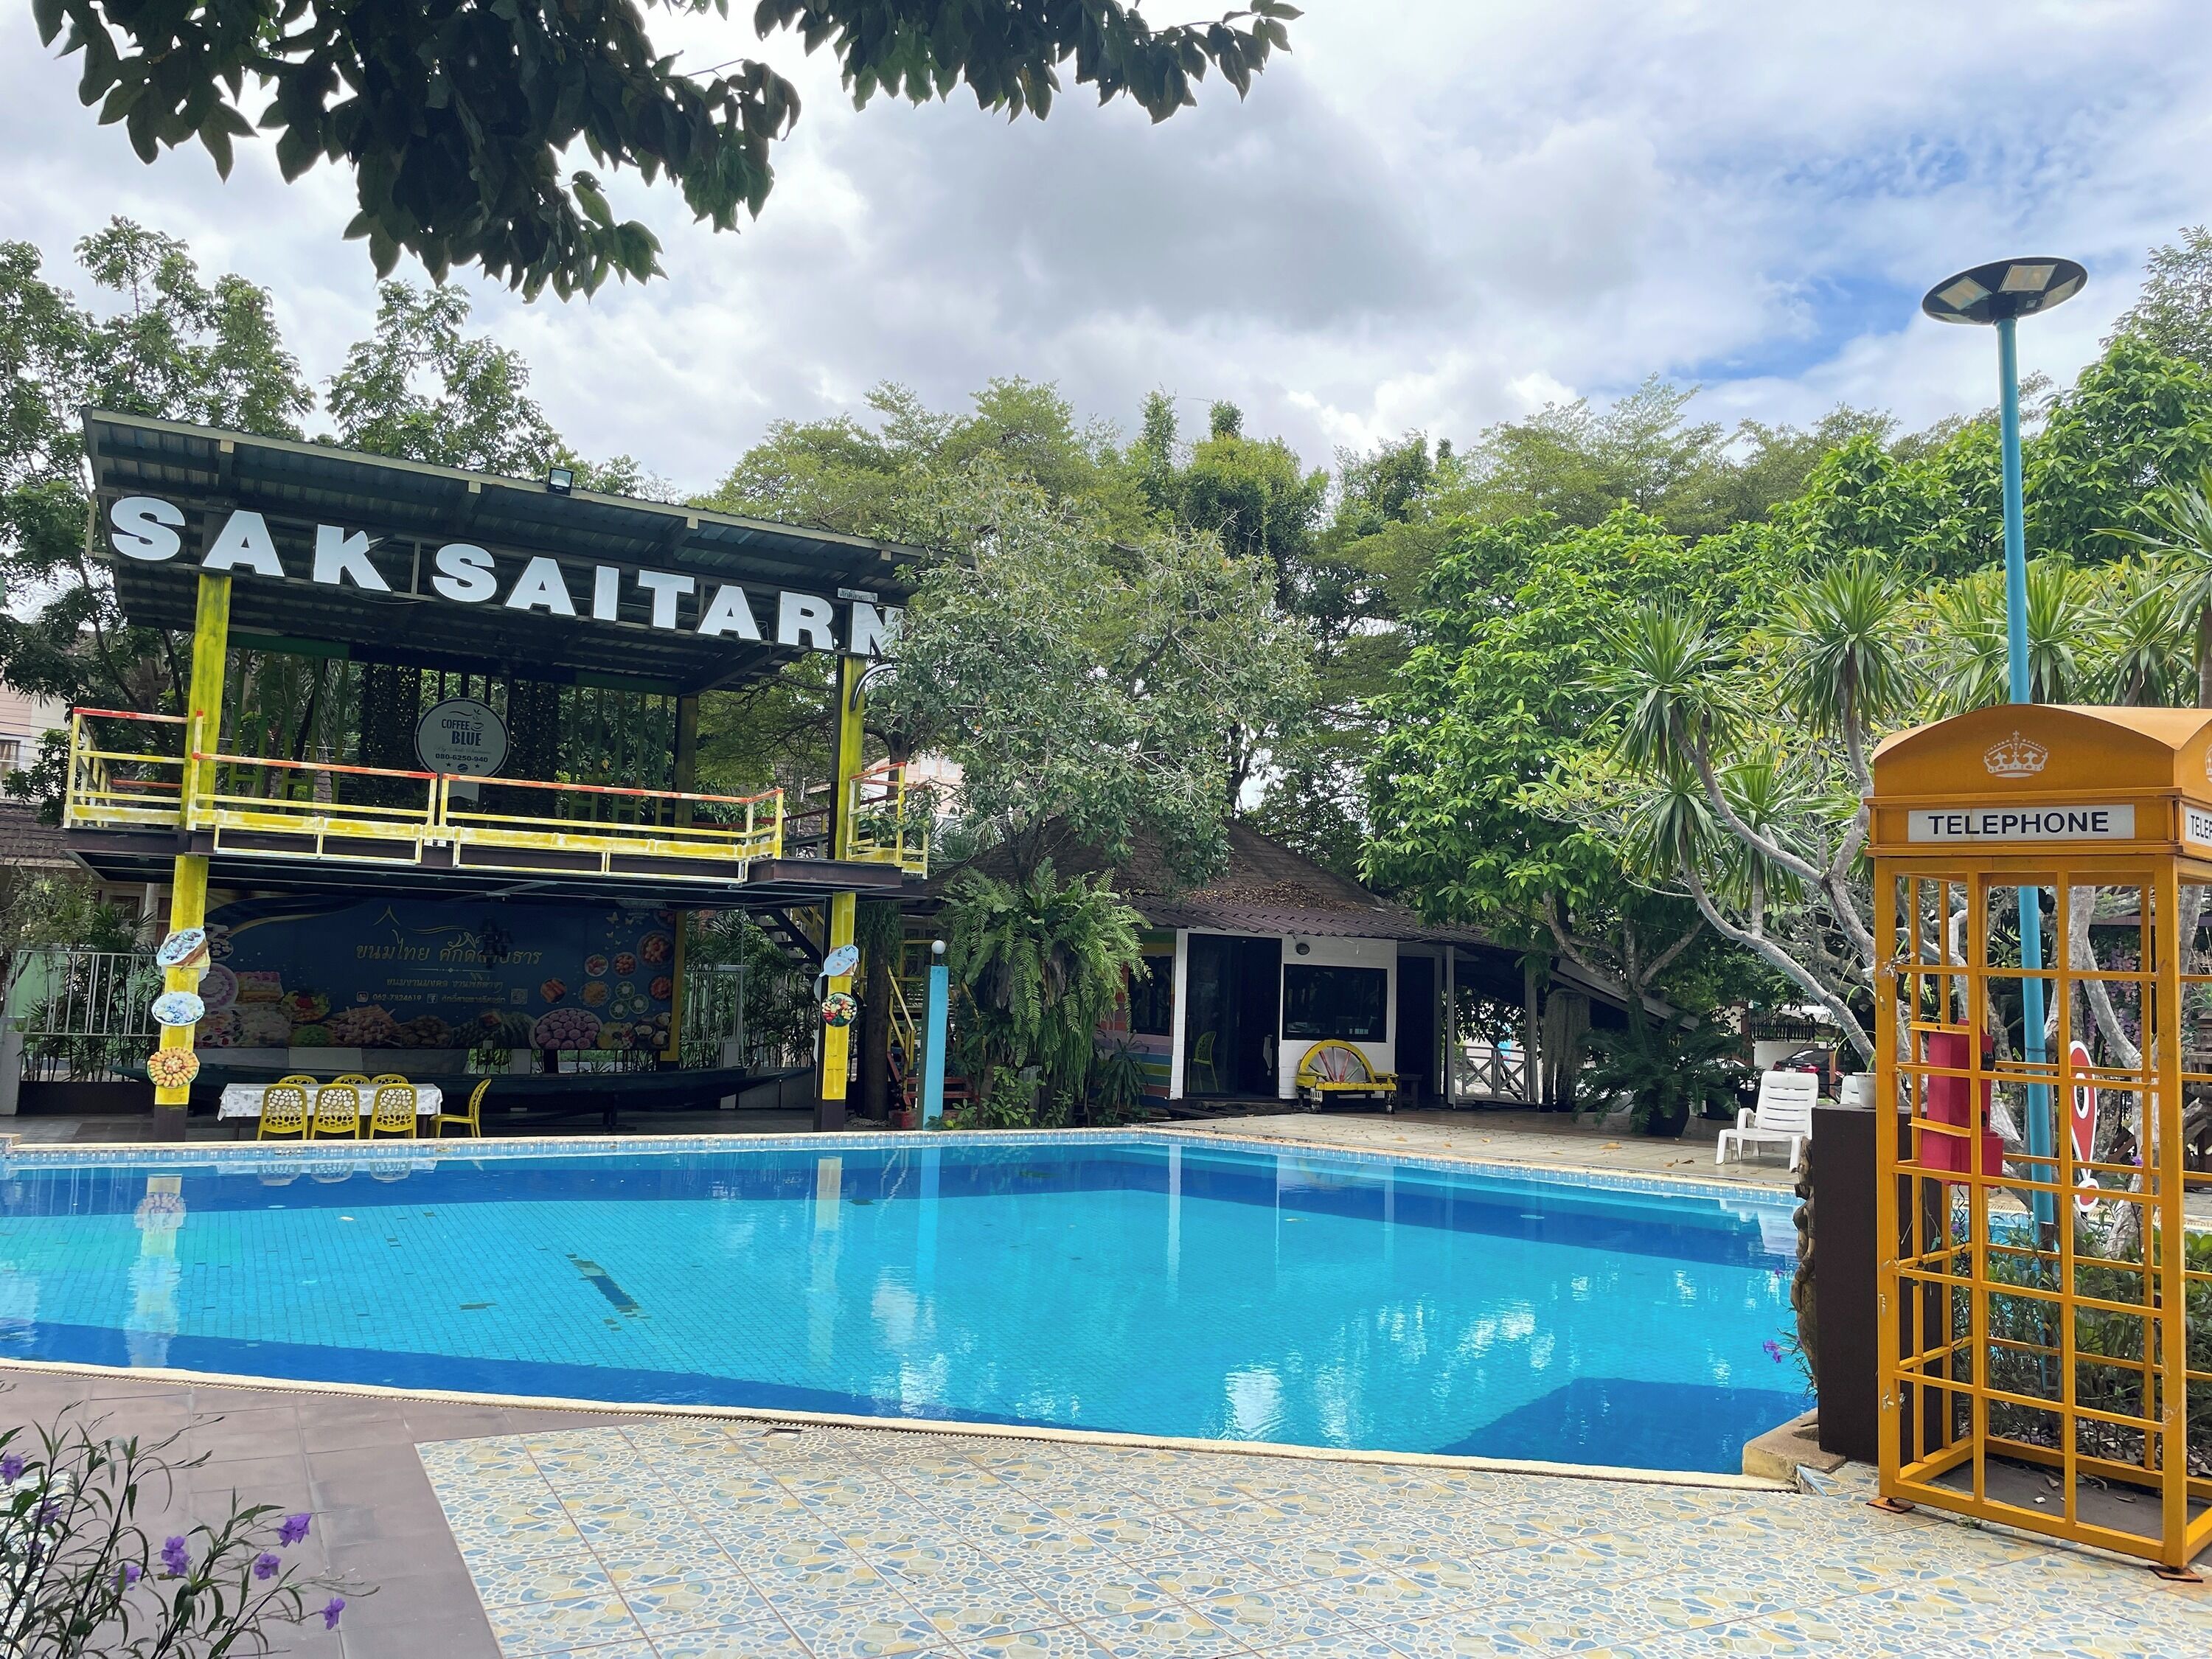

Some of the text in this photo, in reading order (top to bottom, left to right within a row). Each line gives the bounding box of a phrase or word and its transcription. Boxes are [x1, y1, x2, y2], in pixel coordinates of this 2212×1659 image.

[111, 496, 904, 658] SAK SAITARN
[442, 719, 470, 730] COFFEE
[451, 731, 481, 746] BLUE
[435, 753, 488, 762] 080-6250-940
[1927, 811, 2109, 835] TELEPHONE
[356, 929, 431, 960] ขนมไทย
